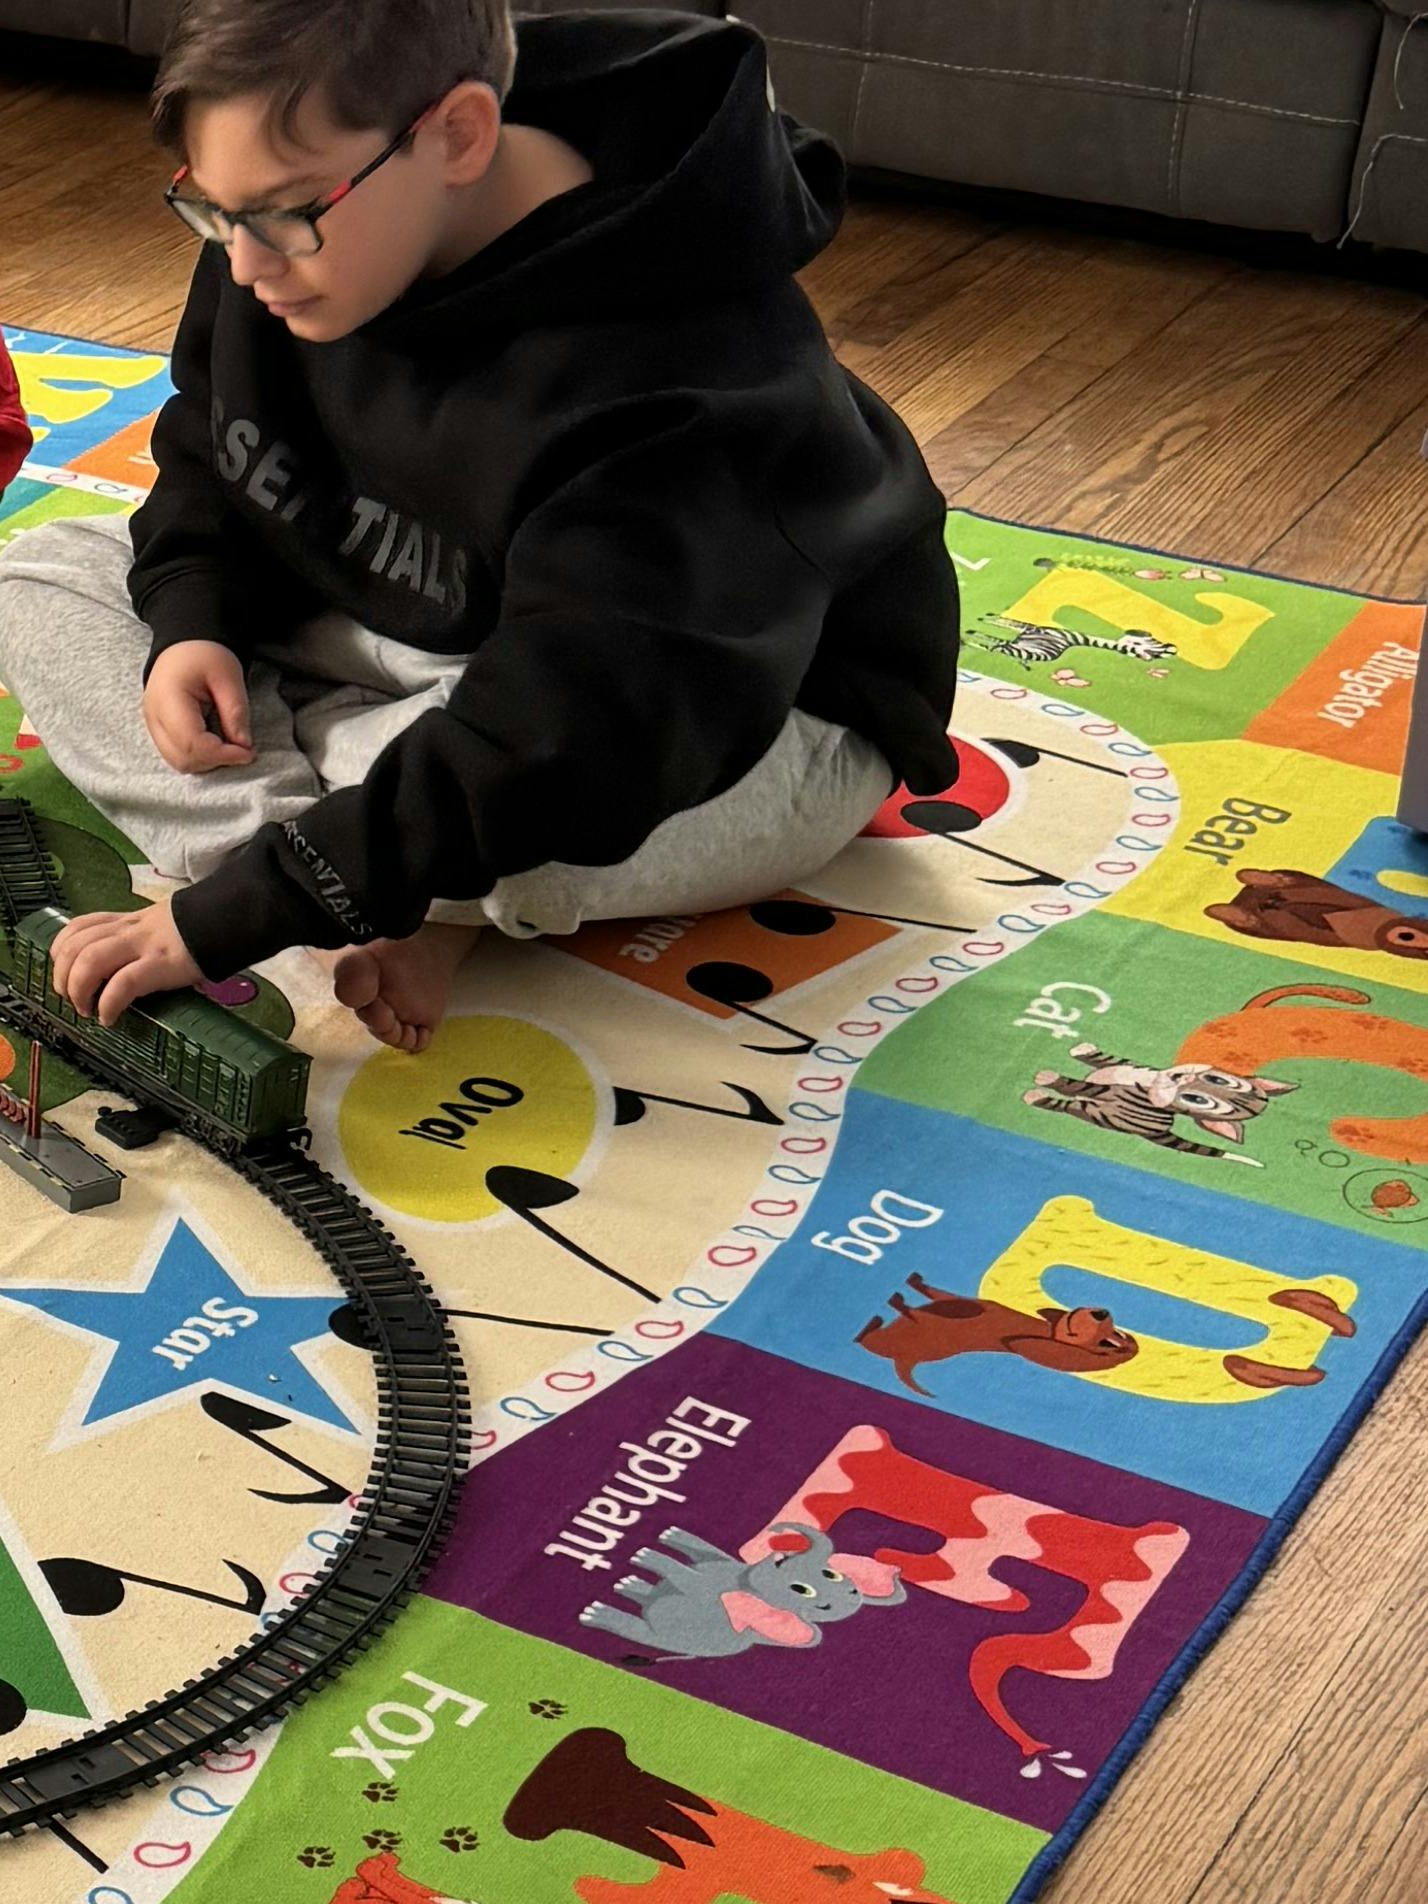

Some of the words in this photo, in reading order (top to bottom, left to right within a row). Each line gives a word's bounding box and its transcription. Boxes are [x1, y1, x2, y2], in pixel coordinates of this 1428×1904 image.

[1184, 796, 1291, 869] Bear
[1012, 981, 1113, 1038] Cat
[398, 1076, 525, 1151] Oval
[811, 1187, 943, 1266] Dog
[150, 1297, 259, 1370] Star
[545, 1393, 753, 1572] Elephant
[330, 1669, 488, 1780] Fox
